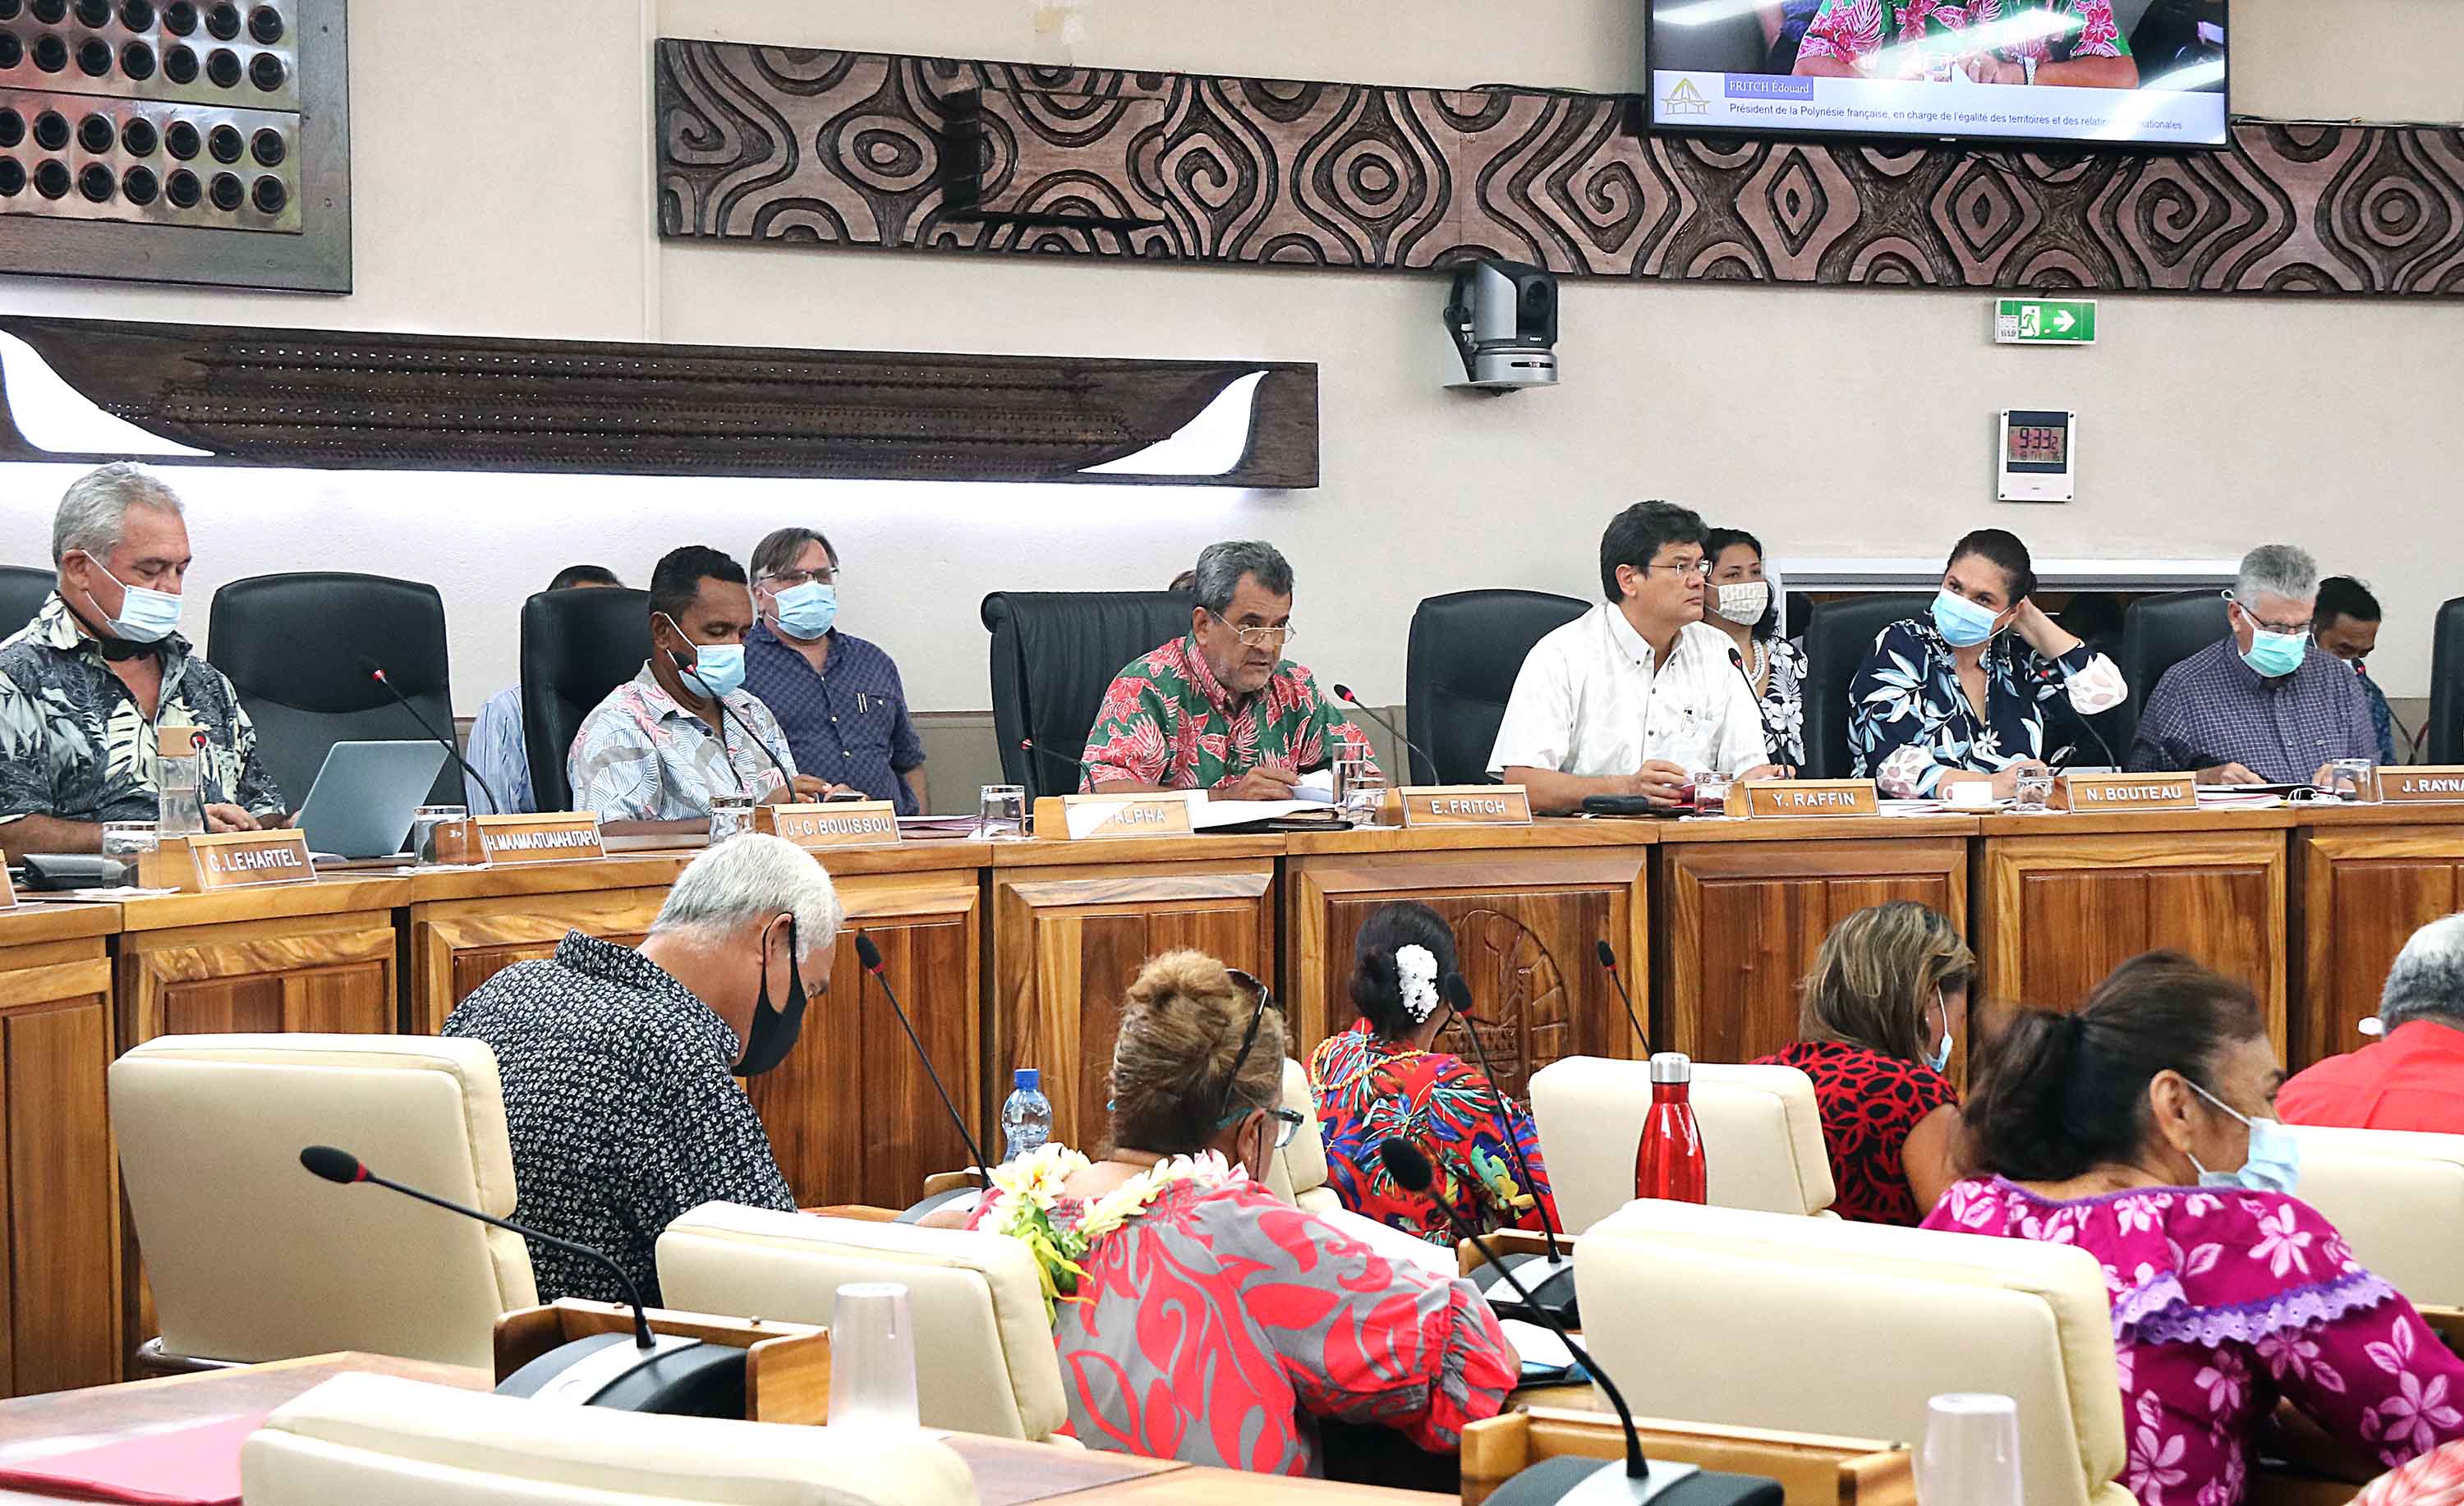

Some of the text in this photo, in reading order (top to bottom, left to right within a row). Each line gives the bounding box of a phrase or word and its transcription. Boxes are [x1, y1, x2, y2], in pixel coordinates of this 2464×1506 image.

[1729, 79, 1809, 94] FRITCH Édouard
[1730, 103, 1772, 114] Président
[1775, 104, 1786, 115] de
[1790, 105, 1798, 115] la
[1800, 105, 1844, 119] Polynésie
[1893, 110, 1905, 119] en
[1907, 109, 1938, 122] charge
[1940, 110, 1951, 121] de
[1990, 113, 2006, 123] des
[2009, 114, 2049, 125] territoires
[2053, 116, 2061, 125] et
[2063, 115, 2079, 126] des
[1793, 792, 1855, 807] RAFFIN
